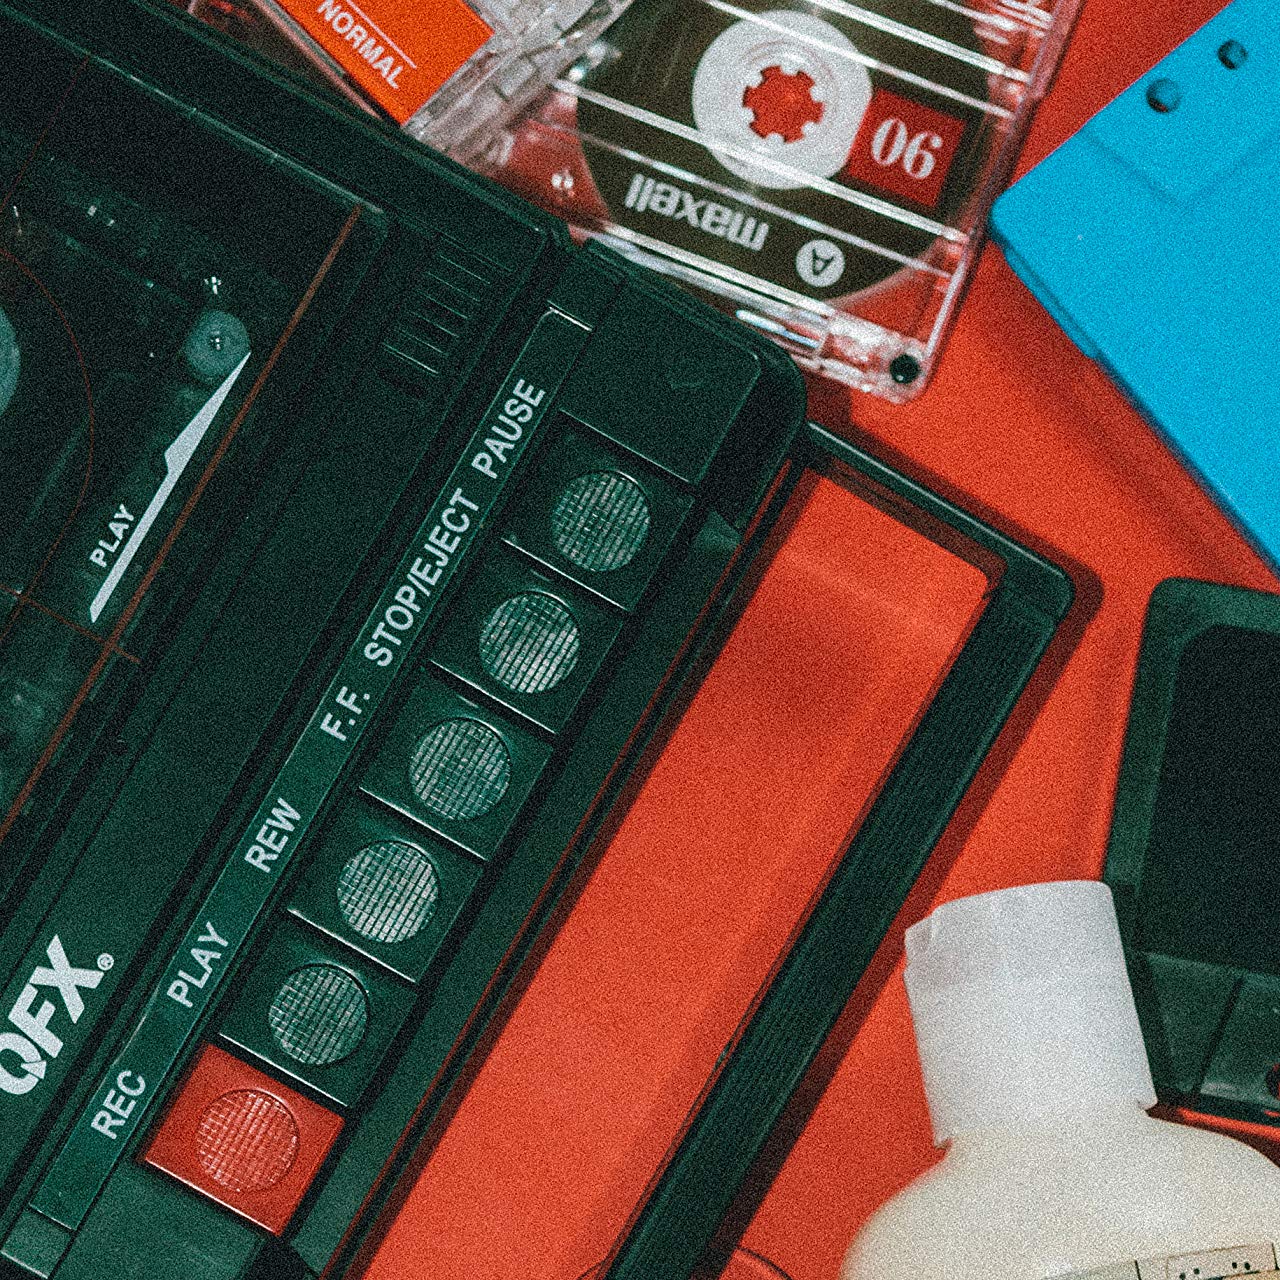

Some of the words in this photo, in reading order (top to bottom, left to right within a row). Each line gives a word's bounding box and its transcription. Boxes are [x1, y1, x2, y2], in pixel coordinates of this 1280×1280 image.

[316, 0, 403, 90] NORMAL
[871, 117, 943, 180] 90
[624, 173, 769, 251] maxell
[472, 378, 547, 480] PAUSE
[89, 503, 136, 567] PLAY
[365, 488, 479, 668] STOP/EJECT
[321, 688, 370, 742] F.F.
[244, 797, 301, 873] REW
[166, 921, 229, 1009] PLAY
[90, 1069, 147, 1140] REC
